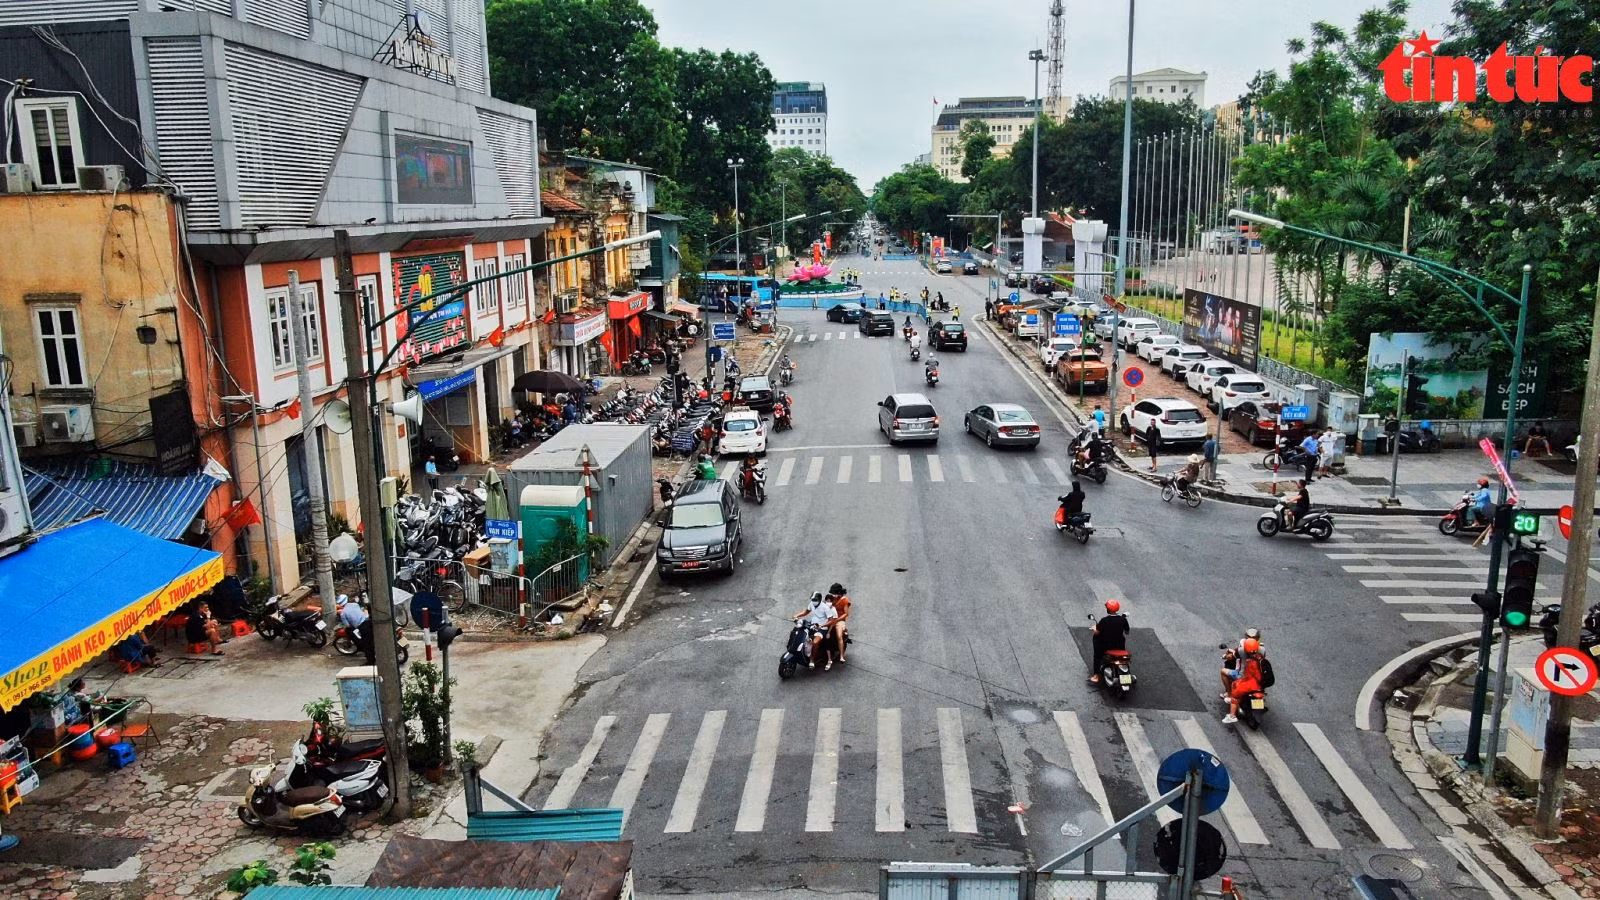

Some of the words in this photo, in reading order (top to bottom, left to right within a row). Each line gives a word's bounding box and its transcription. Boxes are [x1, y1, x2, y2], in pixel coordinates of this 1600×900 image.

[1514, 515, 1535, 531] 20
[3, 661, 48, 691] Shop
[52, 645, 83, 673] BÁNH
[84, 630, 106, 656] KẸO
[113, 610, 140, 638] RƯỢU
[145, 599, 162, 619] BIA
[168, 576, 195, 604] THUỐC
[197, 569, 209, 588] LÁ
